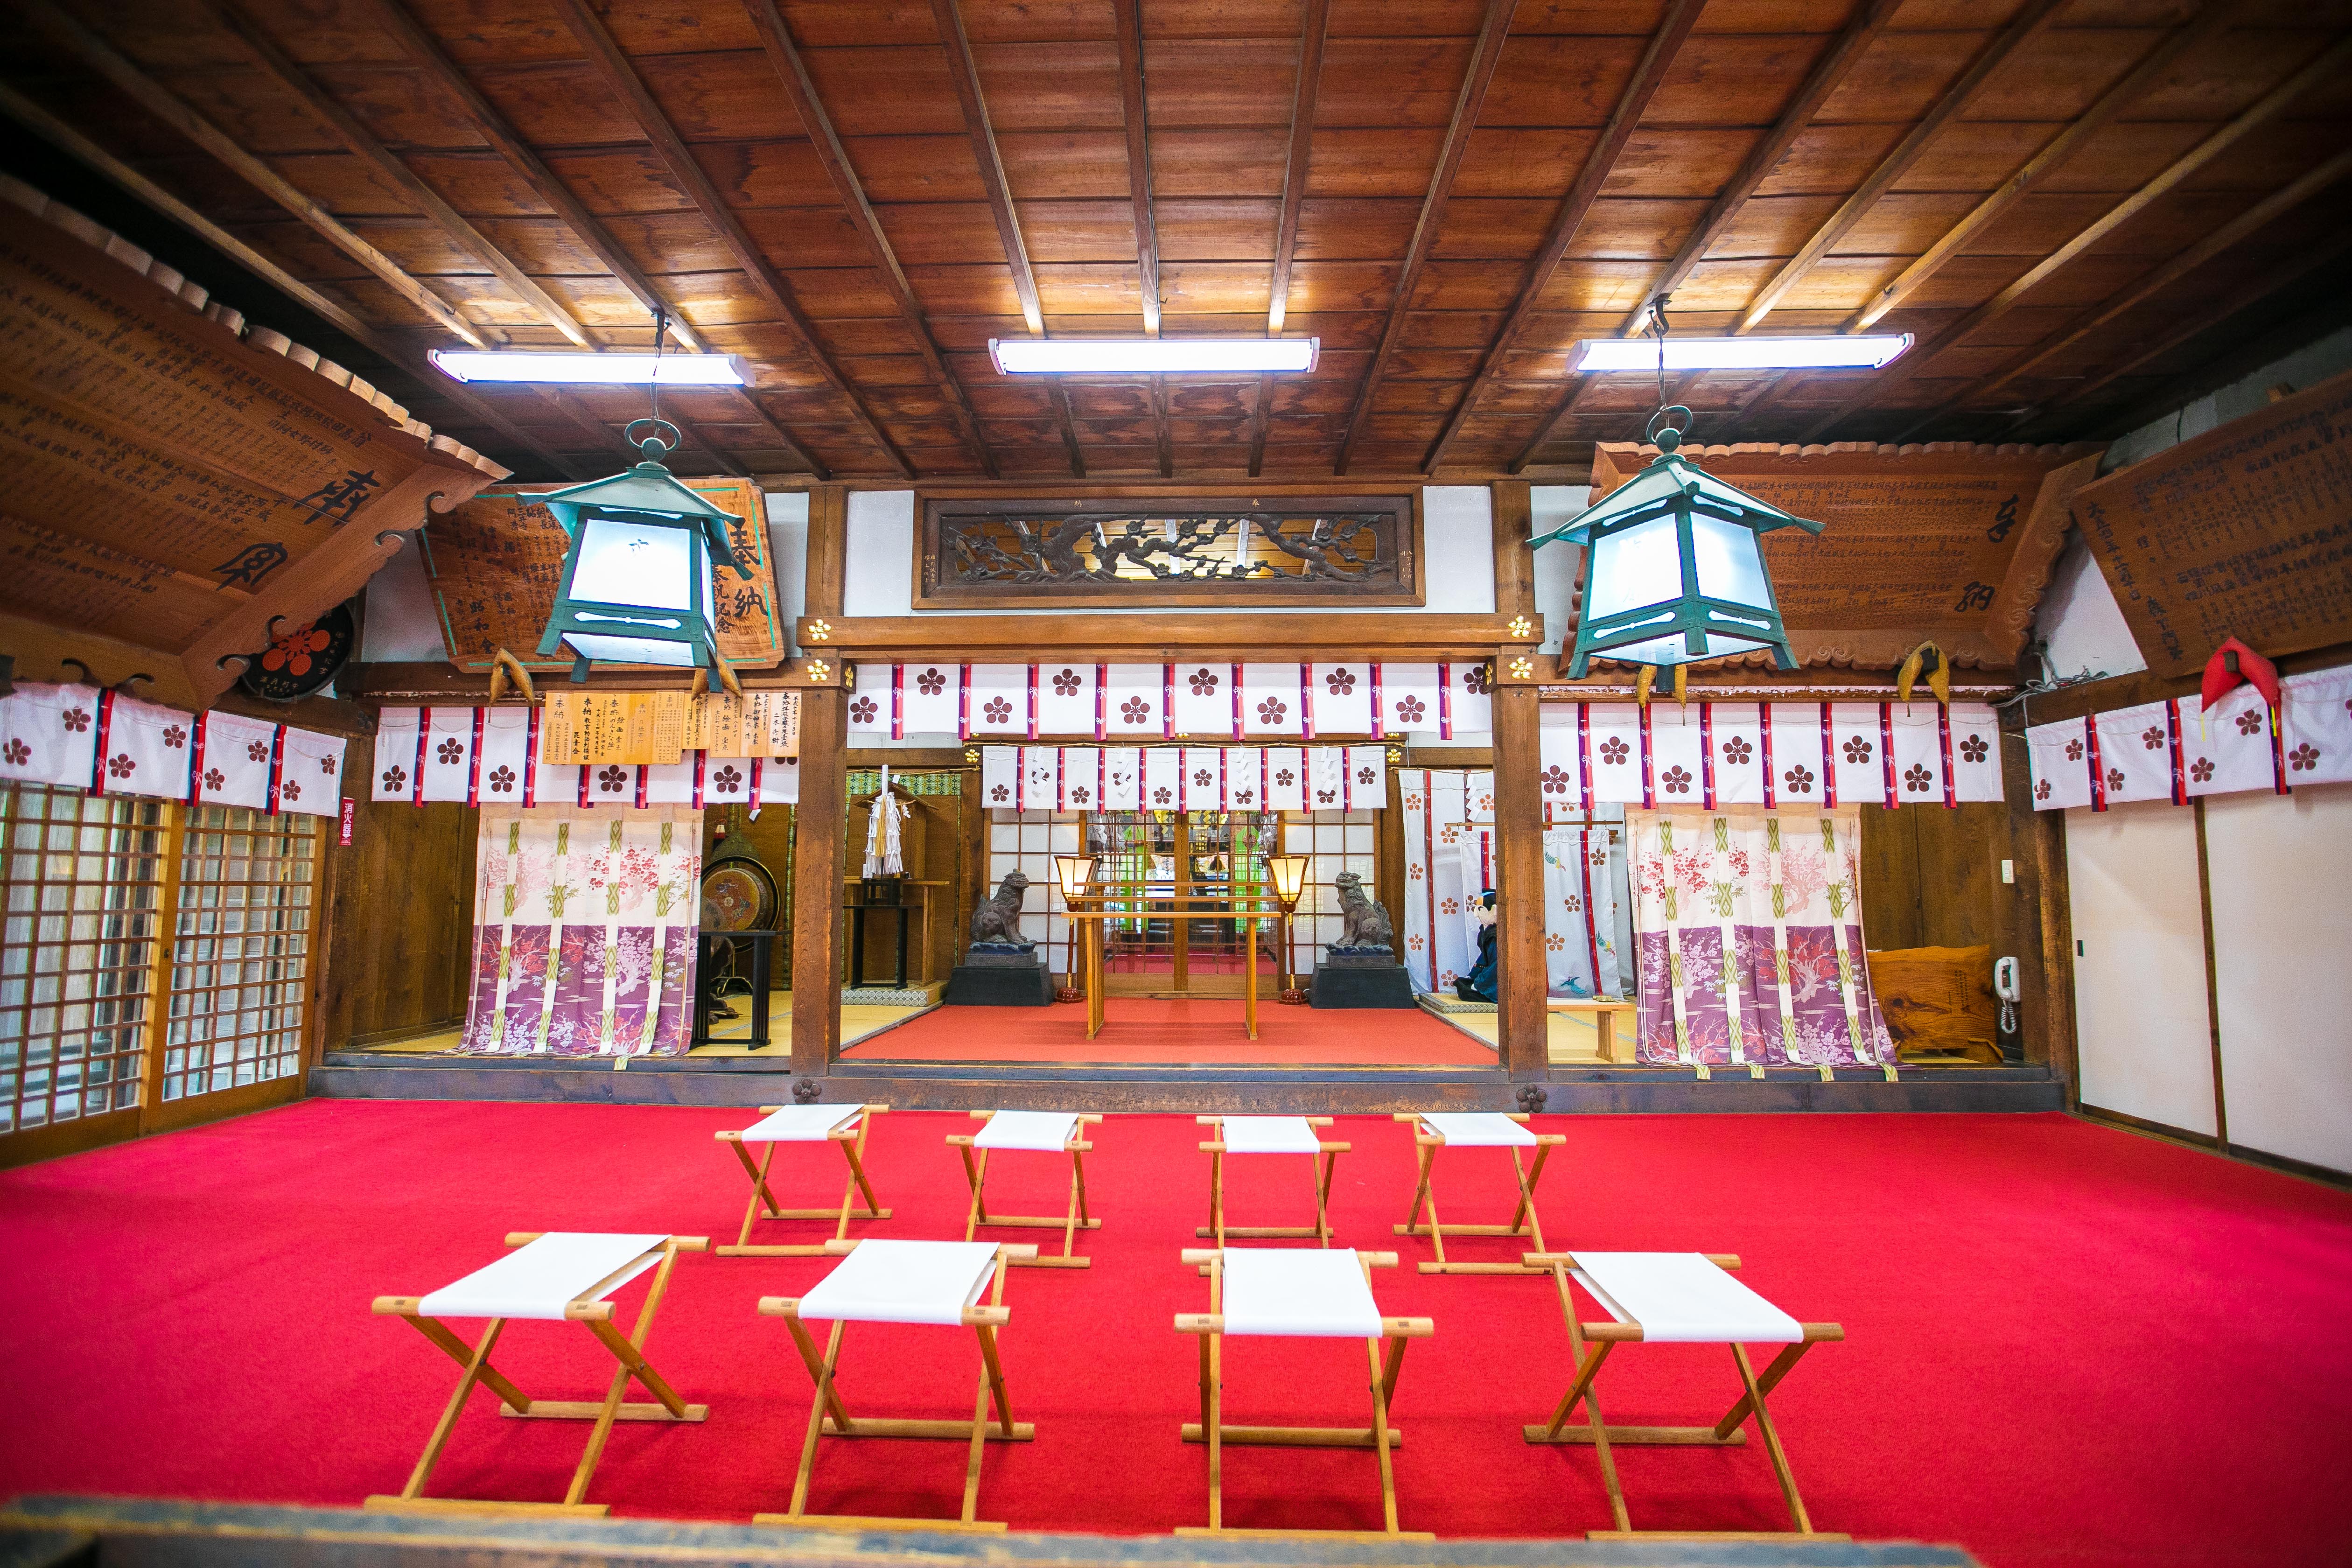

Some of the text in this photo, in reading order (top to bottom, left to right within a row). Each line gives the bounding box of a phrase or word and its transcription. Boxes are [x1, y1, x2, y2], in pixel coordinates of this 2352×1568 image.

[730, 527, 768, 617] 奉納
[554, 697, 565, 719] 奉納
[342, 803, 353, 834] 消火器
